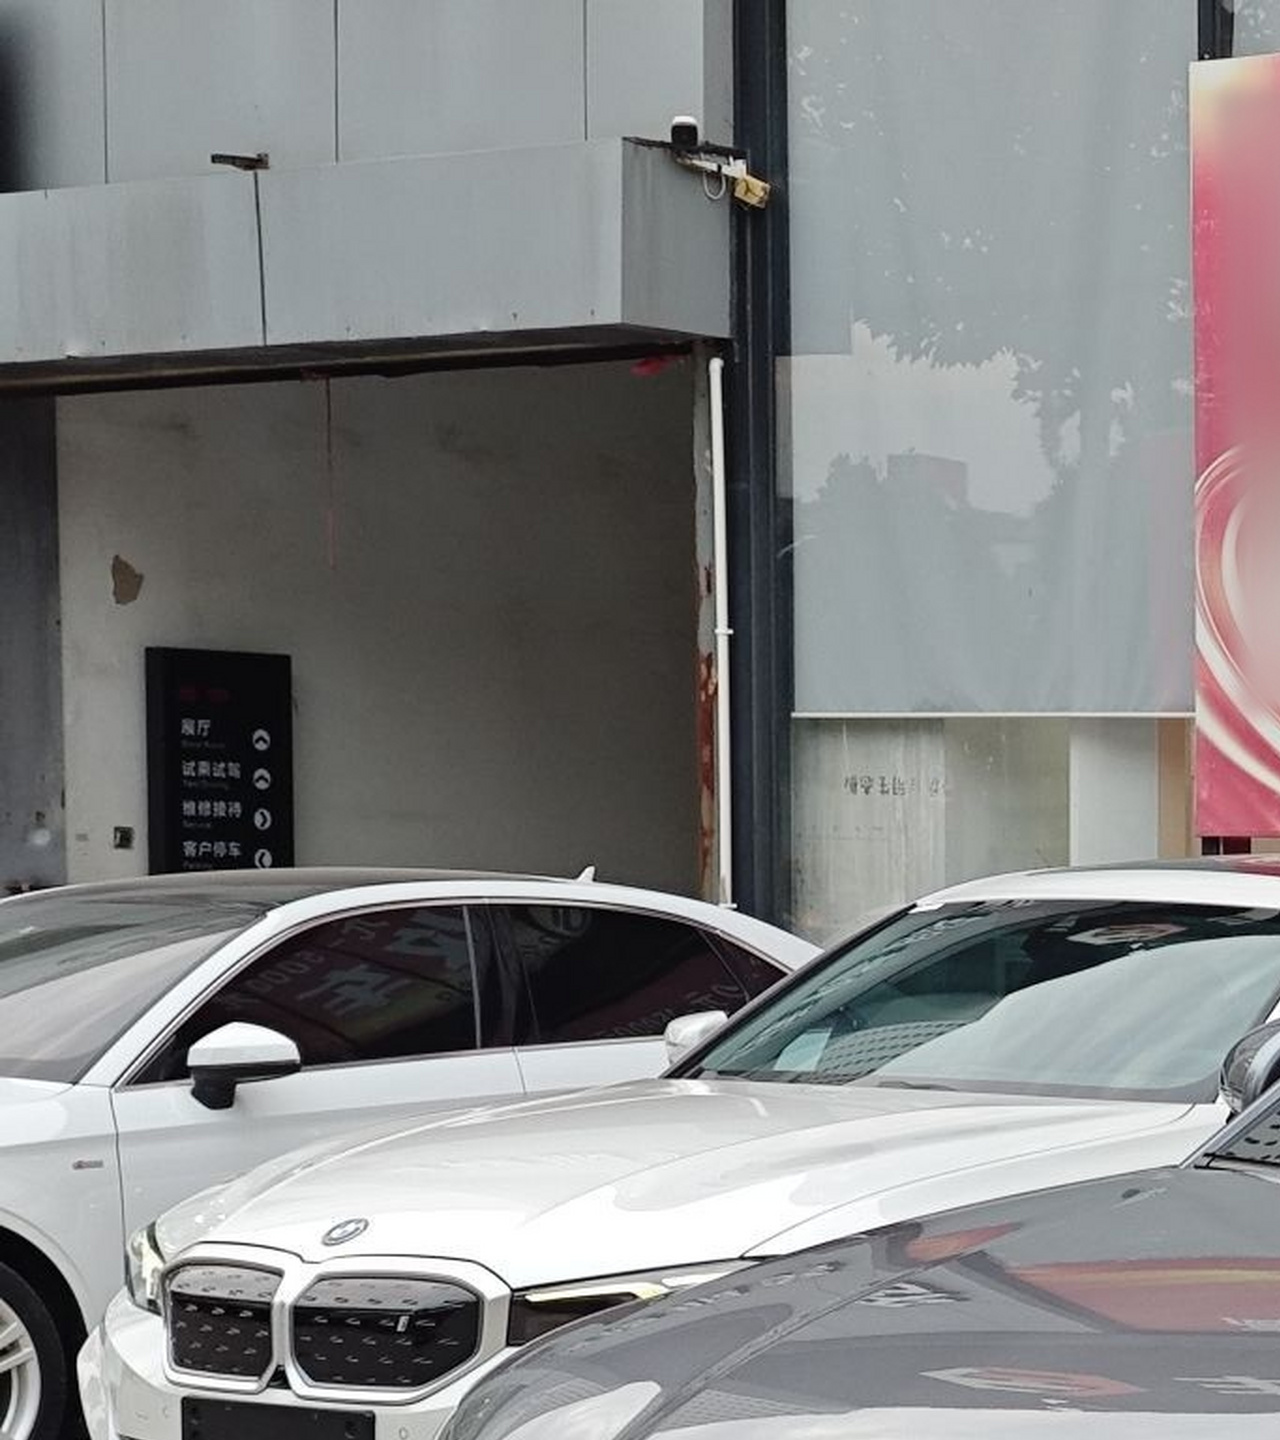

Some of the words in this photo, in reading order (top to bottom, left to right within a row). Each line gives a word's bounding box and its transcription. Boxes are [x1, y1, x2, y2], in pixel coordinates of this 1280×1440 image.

[181, 718, 211, 736] 展厅
[182, 801, 242, 818] 维修接待
[182, 841, 242, 858] 客户停车
